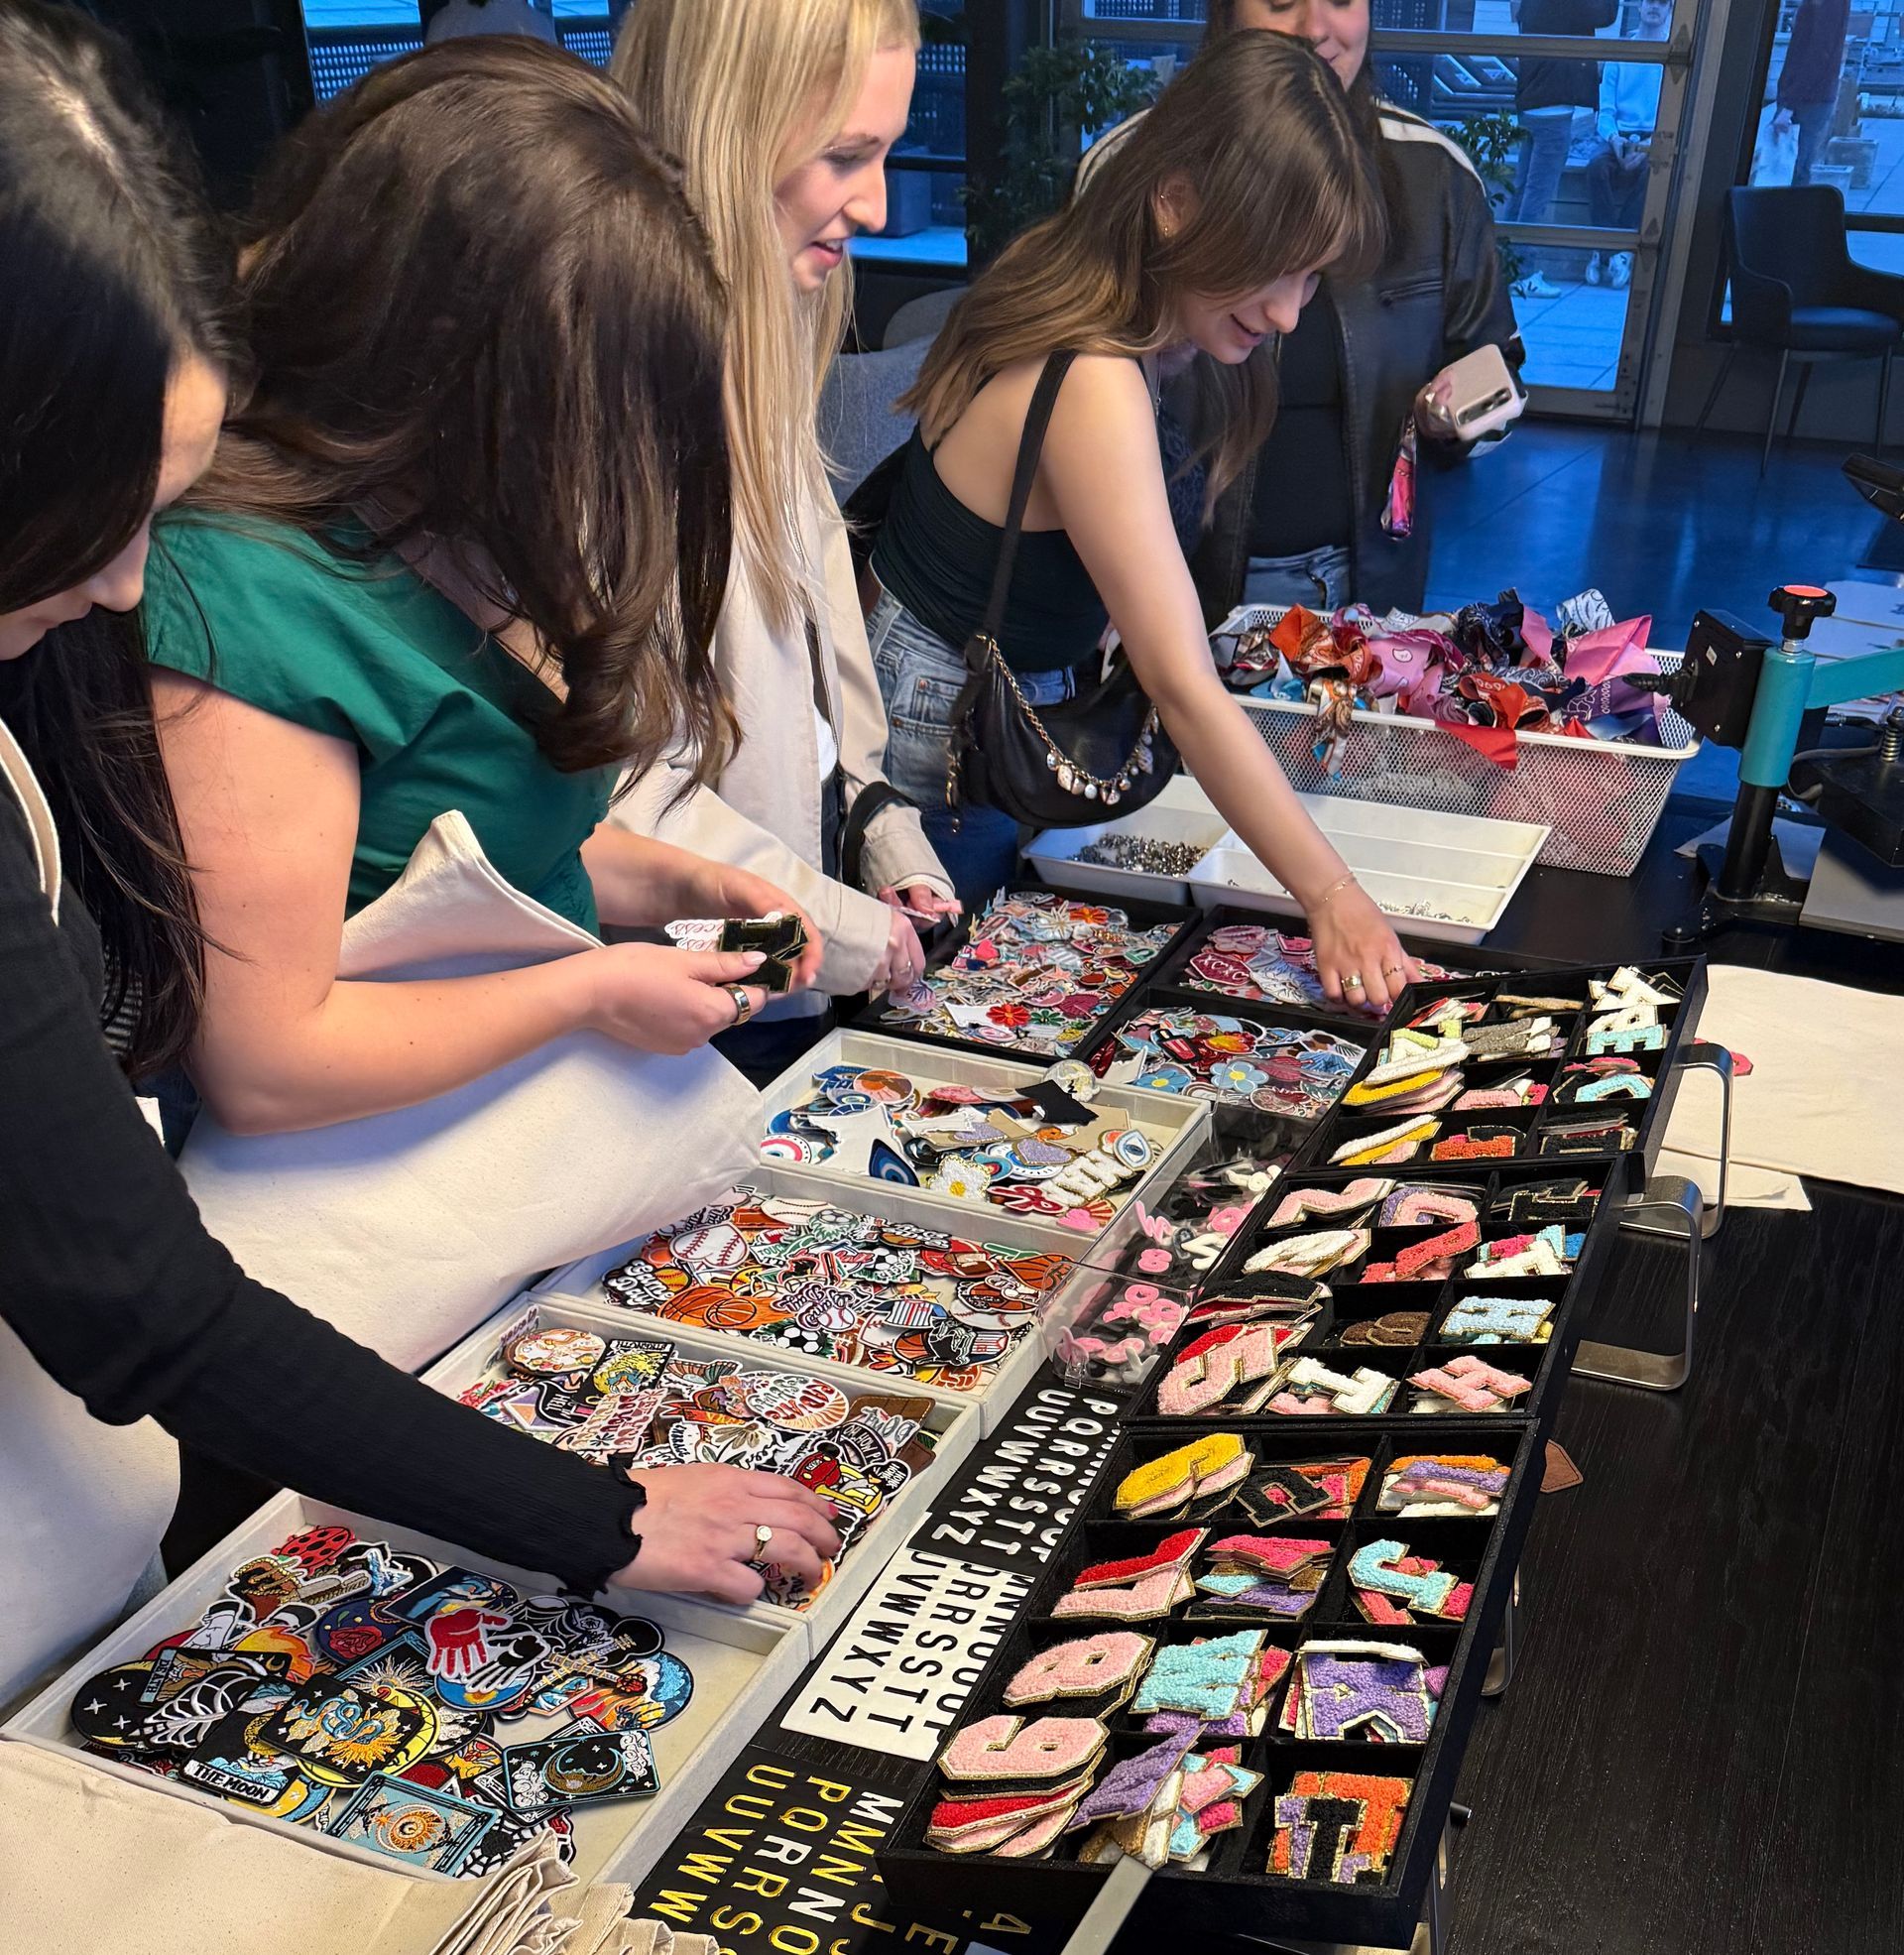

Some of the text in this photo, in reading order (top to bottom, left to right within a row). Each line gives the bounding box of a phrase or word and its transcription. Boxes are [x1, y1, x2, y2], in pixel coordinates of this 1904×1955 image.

[608, 1276, 654, 1306] Day
[625, 1259, 675, 1301] Game
[146, 1658, 171, 1693] DEATH
[193, 1762, 271, 1799] THE MOON
